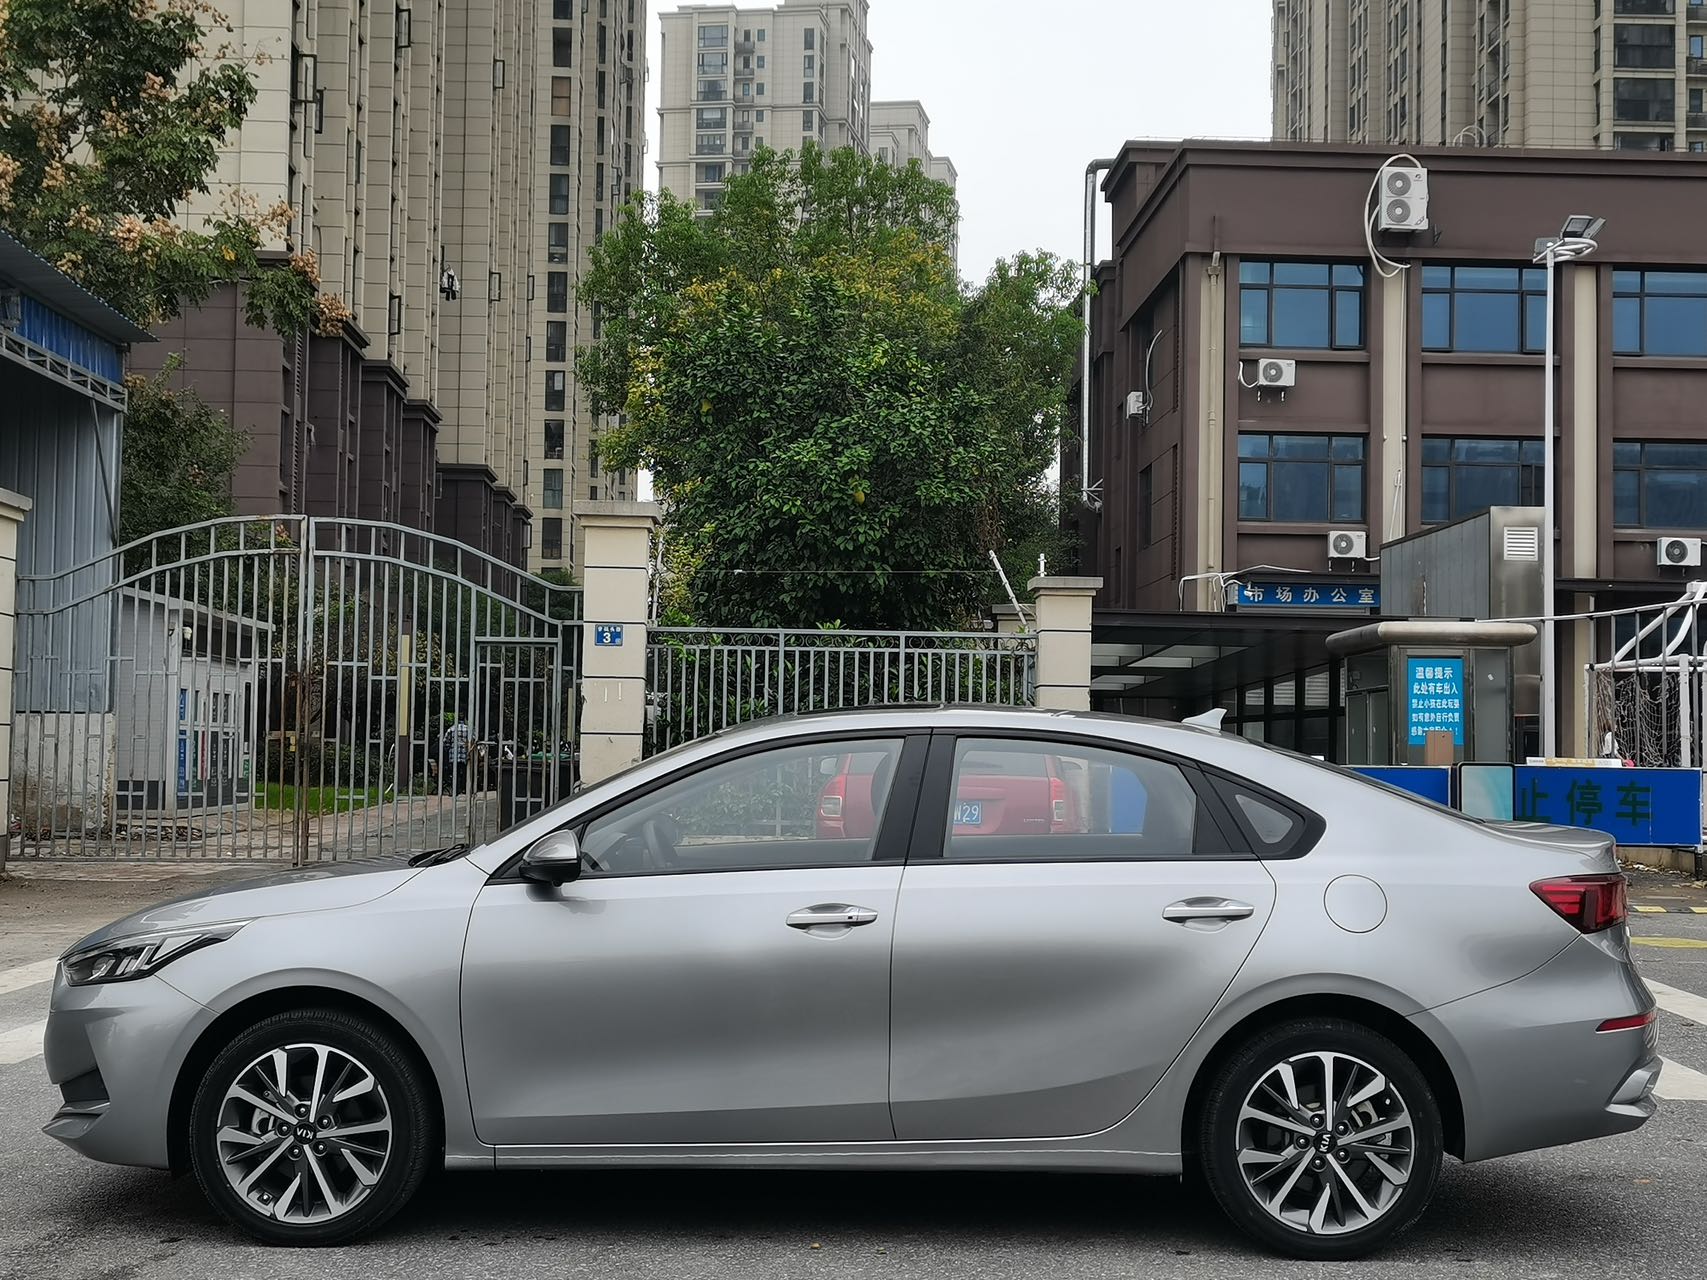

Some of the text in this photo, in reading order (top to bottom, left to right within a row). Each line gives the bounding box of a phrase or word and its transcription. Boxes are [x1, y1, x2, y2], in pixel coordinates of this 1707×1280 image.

[1246, 586, 1375, 603] 市场办公室
[603, 632, 611, 643] 3
[1415, 666, 1453, 680] 温馨提示
[1413, 682, 1459, 695] 此处有车出入
[296, 1127, 314, 1140] KIA
[1320, 1134, 1331, 1152] KIA
